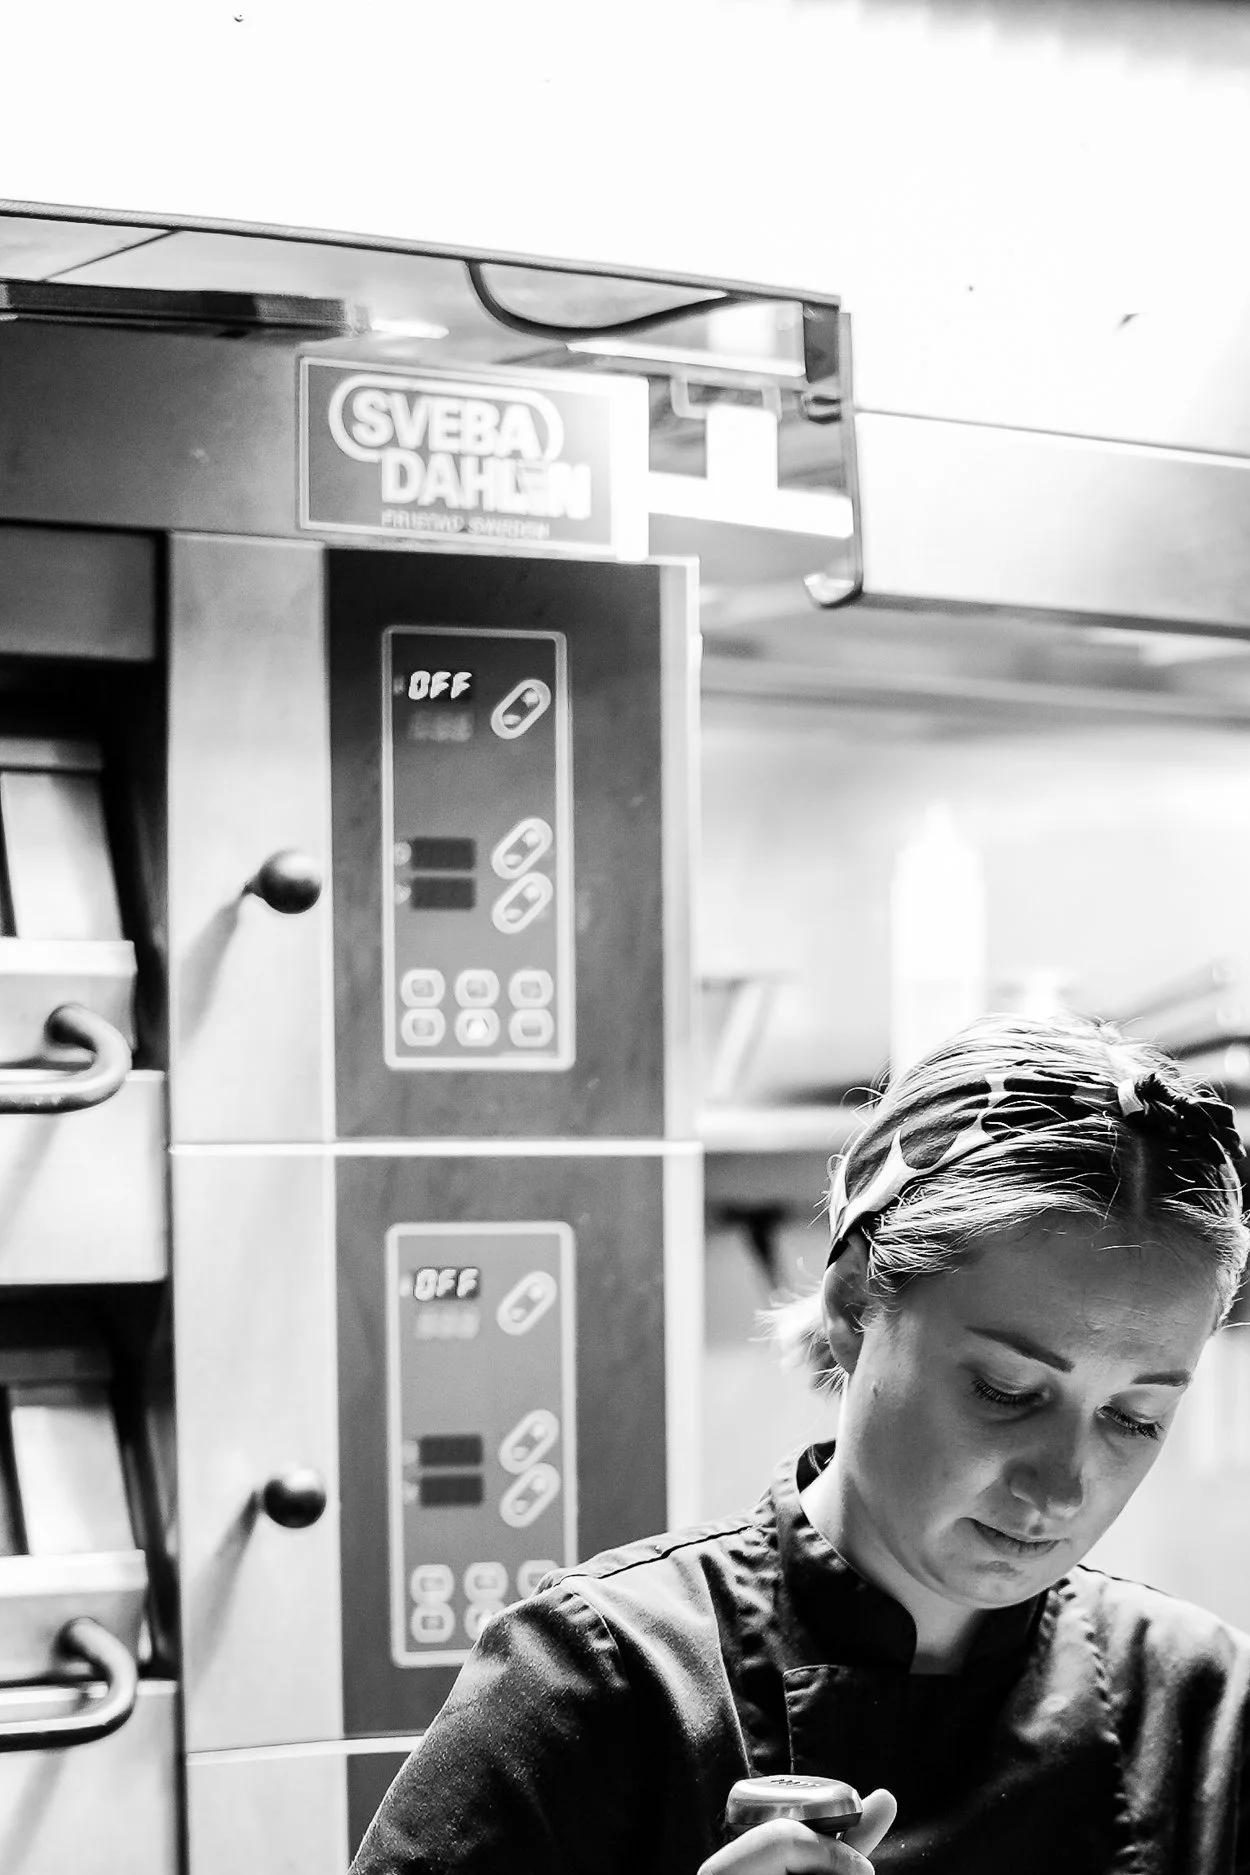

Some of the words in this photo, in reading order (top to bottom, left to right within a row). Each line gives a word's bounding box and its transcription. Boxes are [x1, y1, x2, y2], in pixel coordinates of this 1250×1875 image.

[352, 389, 542, 460] SVEBA
[408, 670, 473, 700] OFF
[415, 1267, 479, 1301] OFF
